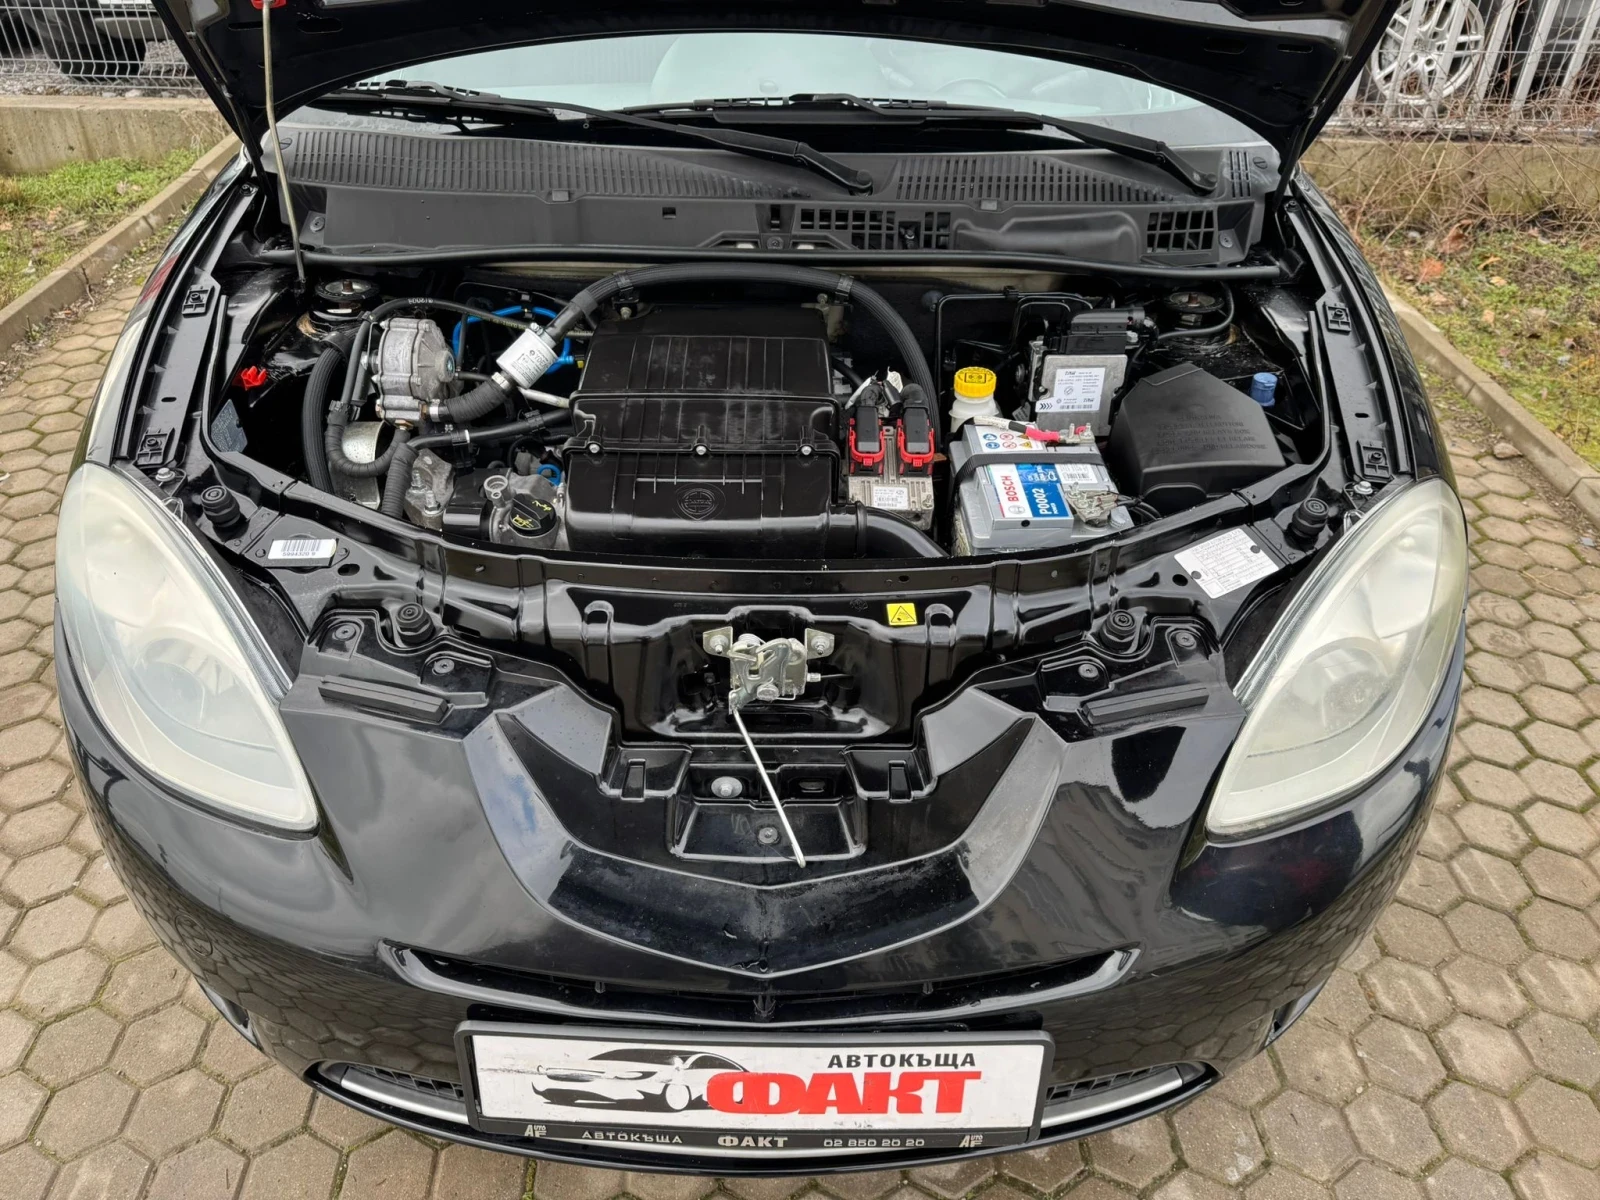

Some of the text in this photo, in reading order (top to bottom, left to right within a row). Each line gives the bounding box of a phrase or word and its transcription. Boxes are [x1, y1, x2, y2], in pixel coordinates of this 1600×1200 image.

[1001, 475, 1019, 502] BOSCH
[1032, 488, 1052, 515] P0002
[827, 1053, 976, 1069] АВТОКЪЩА
[706, 1071, 982, 1115] ФАКТ
[717, 1135, 788, 1148] ФАКТ
[823, 1139, 843, 1147] 02
[847, 1138, 877, 1147] 850
[881, 1138, 901, 1147] 20
[905, 1138, 925, 1147] 20
